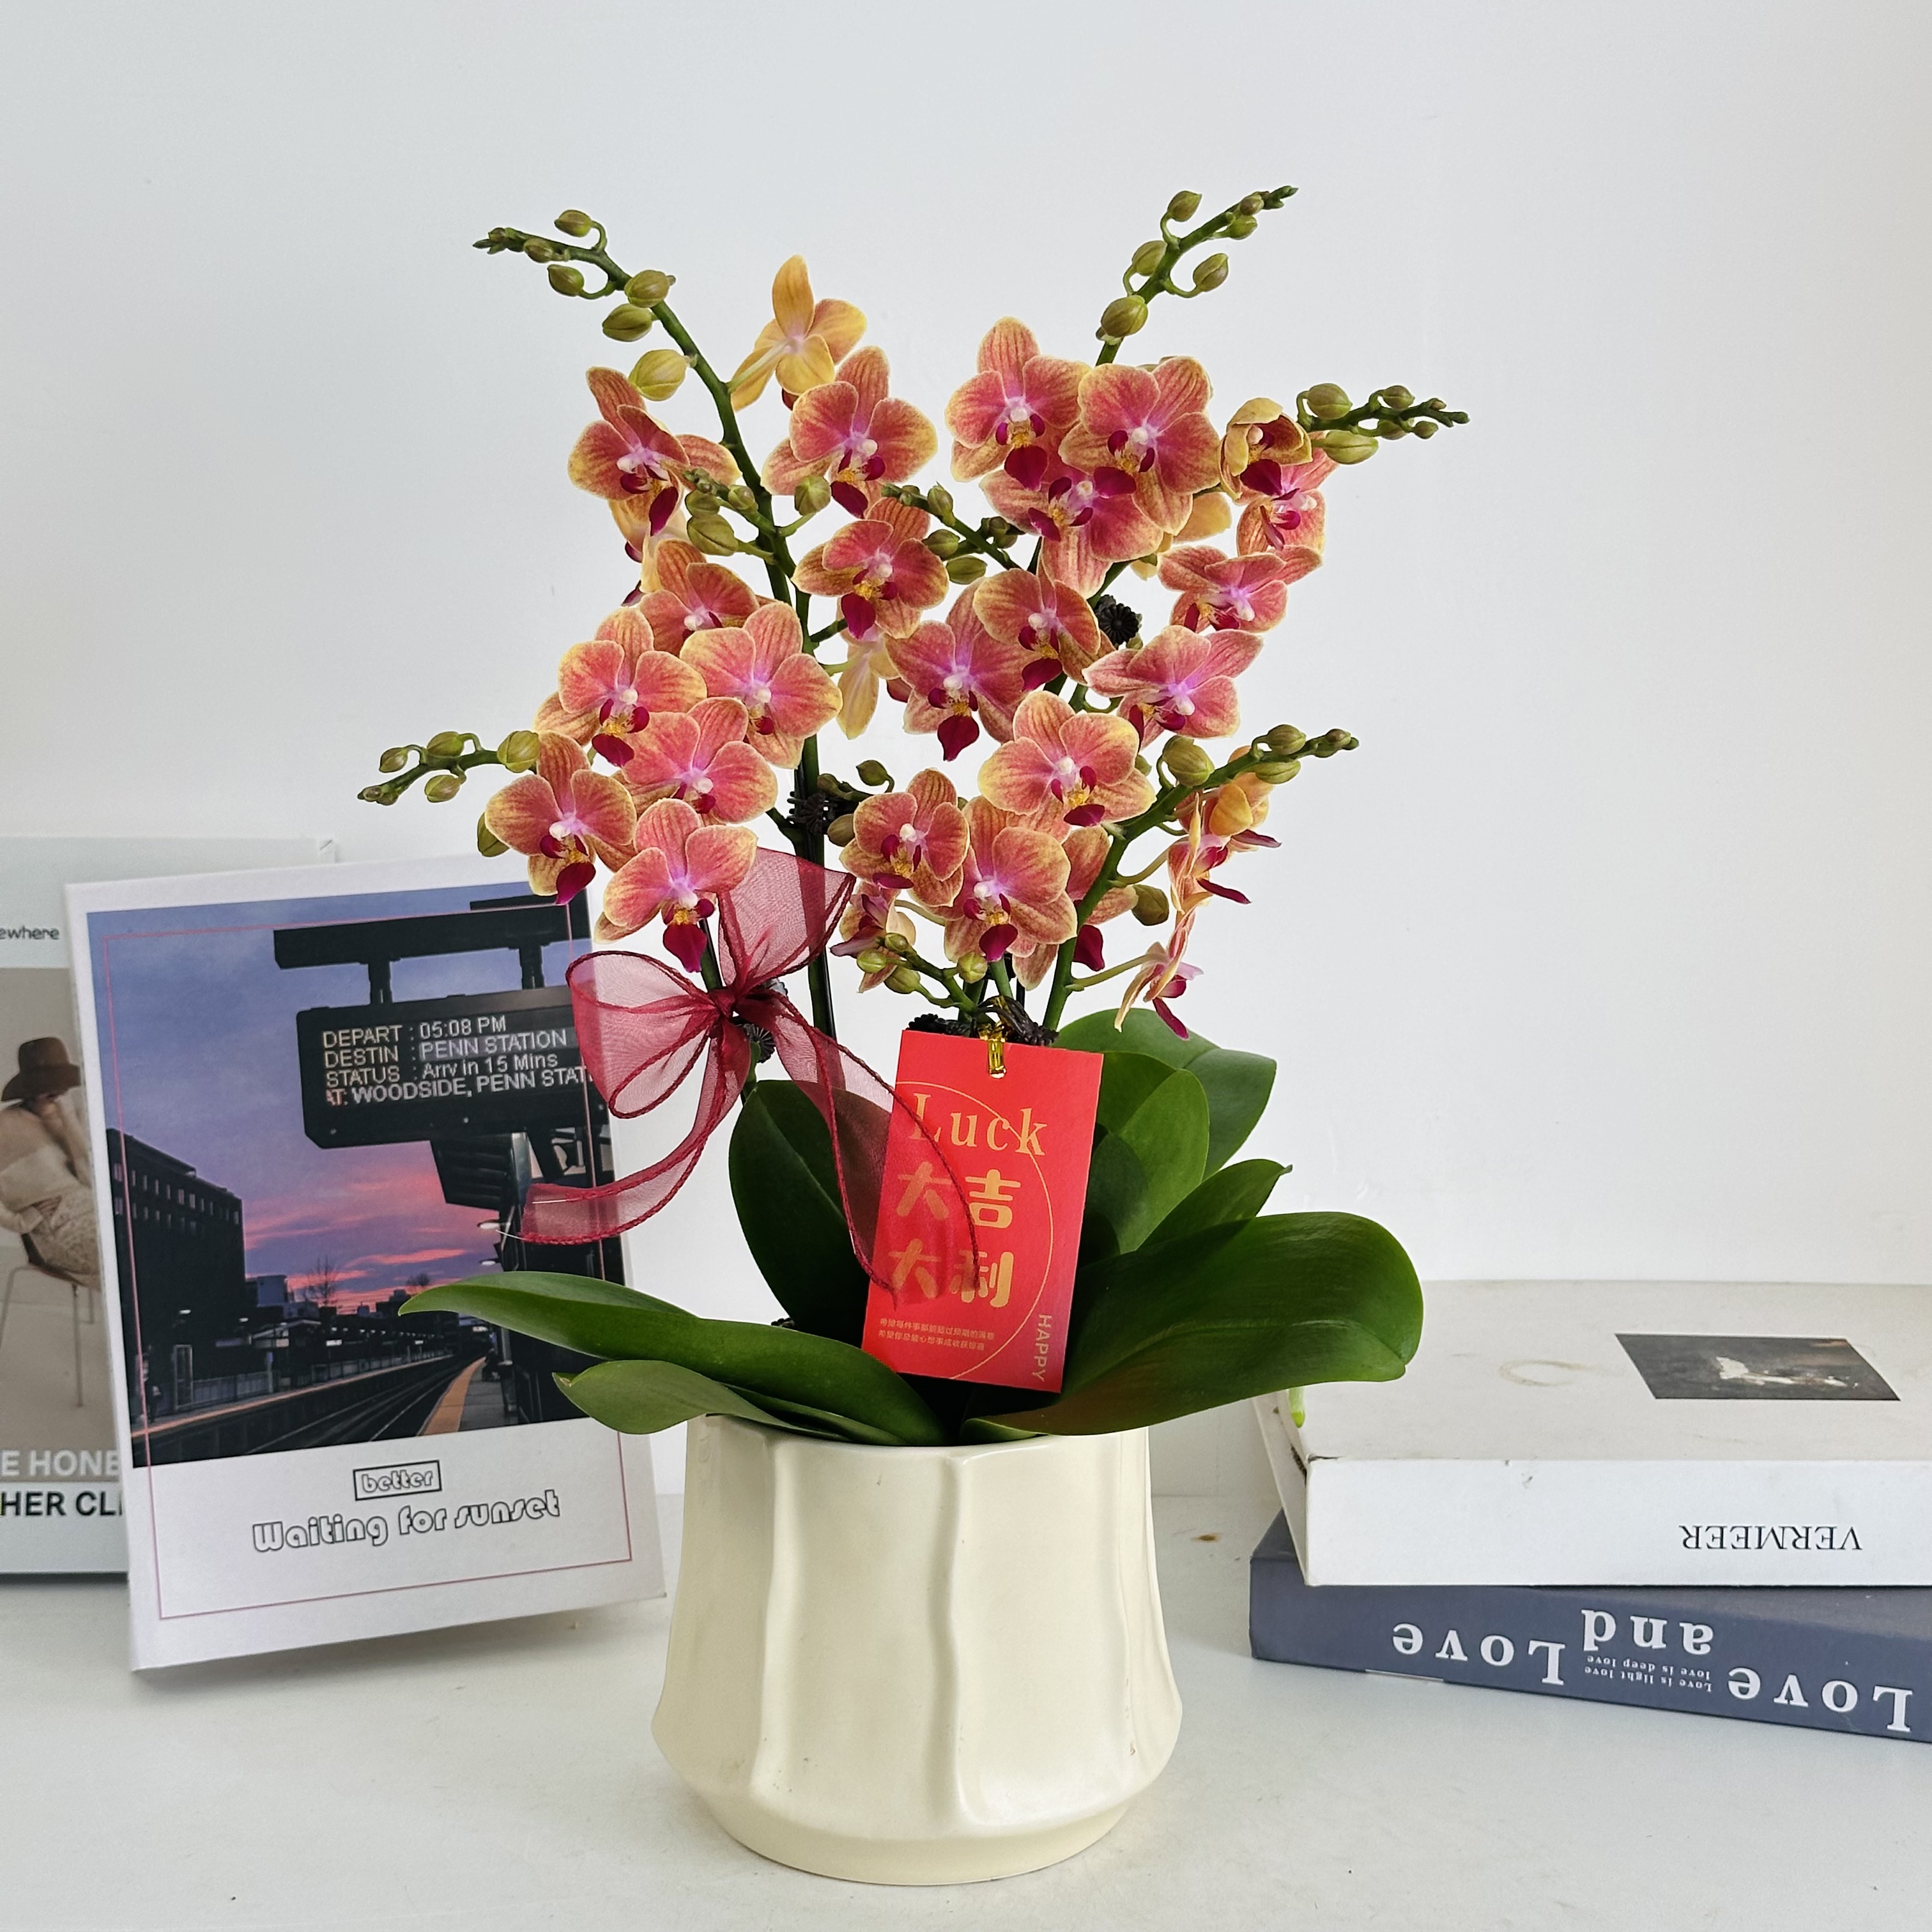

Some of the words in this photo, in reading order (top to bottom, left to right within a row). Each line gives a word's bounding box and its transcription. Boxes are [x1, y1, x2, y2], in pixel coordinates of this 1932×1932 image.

[323, 1025, 402, 1048] DEPART
[420, 1018, 472, 1039] 05:08
[478, 1015, 506, 1034] PM
[325, 1045, 399, 1068] DESTIN
[422, 1038, 479, 1059] PENN
[486, 1029, 567, 1054] STATION
[326, 1065, 400, 1088] STATUS
[463, 1059, 479, 1076] in
[486, 1055, 508, 1073] 15
[514, 1054, 558, 1071] Mins
[351, 1077, 472, 1104] WOODSIDE,
[477, 1071, 535, 1093] PENN
[910, 1092, 1048, 1156] Luck
[896, 1161, 1022, 1229] 大吉
[888, 1238, 1015, 1308] 大利
[1032, 1314, 1052, 1382] HAPPY
[362, 1469, 434, 1493] better
[75, 1490, 123, 1517] CL
[252, 1514, 388, 1552] Waiting
[398, 1505, 447, 1535] for
[454, 1489, 560, 1529] sunset
[1678, 1524, 1862, 1551] VERMEER
[1581, 1609, 1714, 1655] and
[1392, 1623, 1567, 1686] Love
[1587, 1655, 1617, 1668] love
[1623, 1658, 1656, 1672] deep
[1662, 1665, 1675, 1676] is
[1584, 1666, 1614, 1679] love
[1620, 1670, 1654, 1685] light
[1660, 1675, 1672, 1688] is
[1678, 1678, 1712, 1693] Love
[1680, 1667, 1710, 1681] love
[1726, 1666, 1914, 1733] Love
